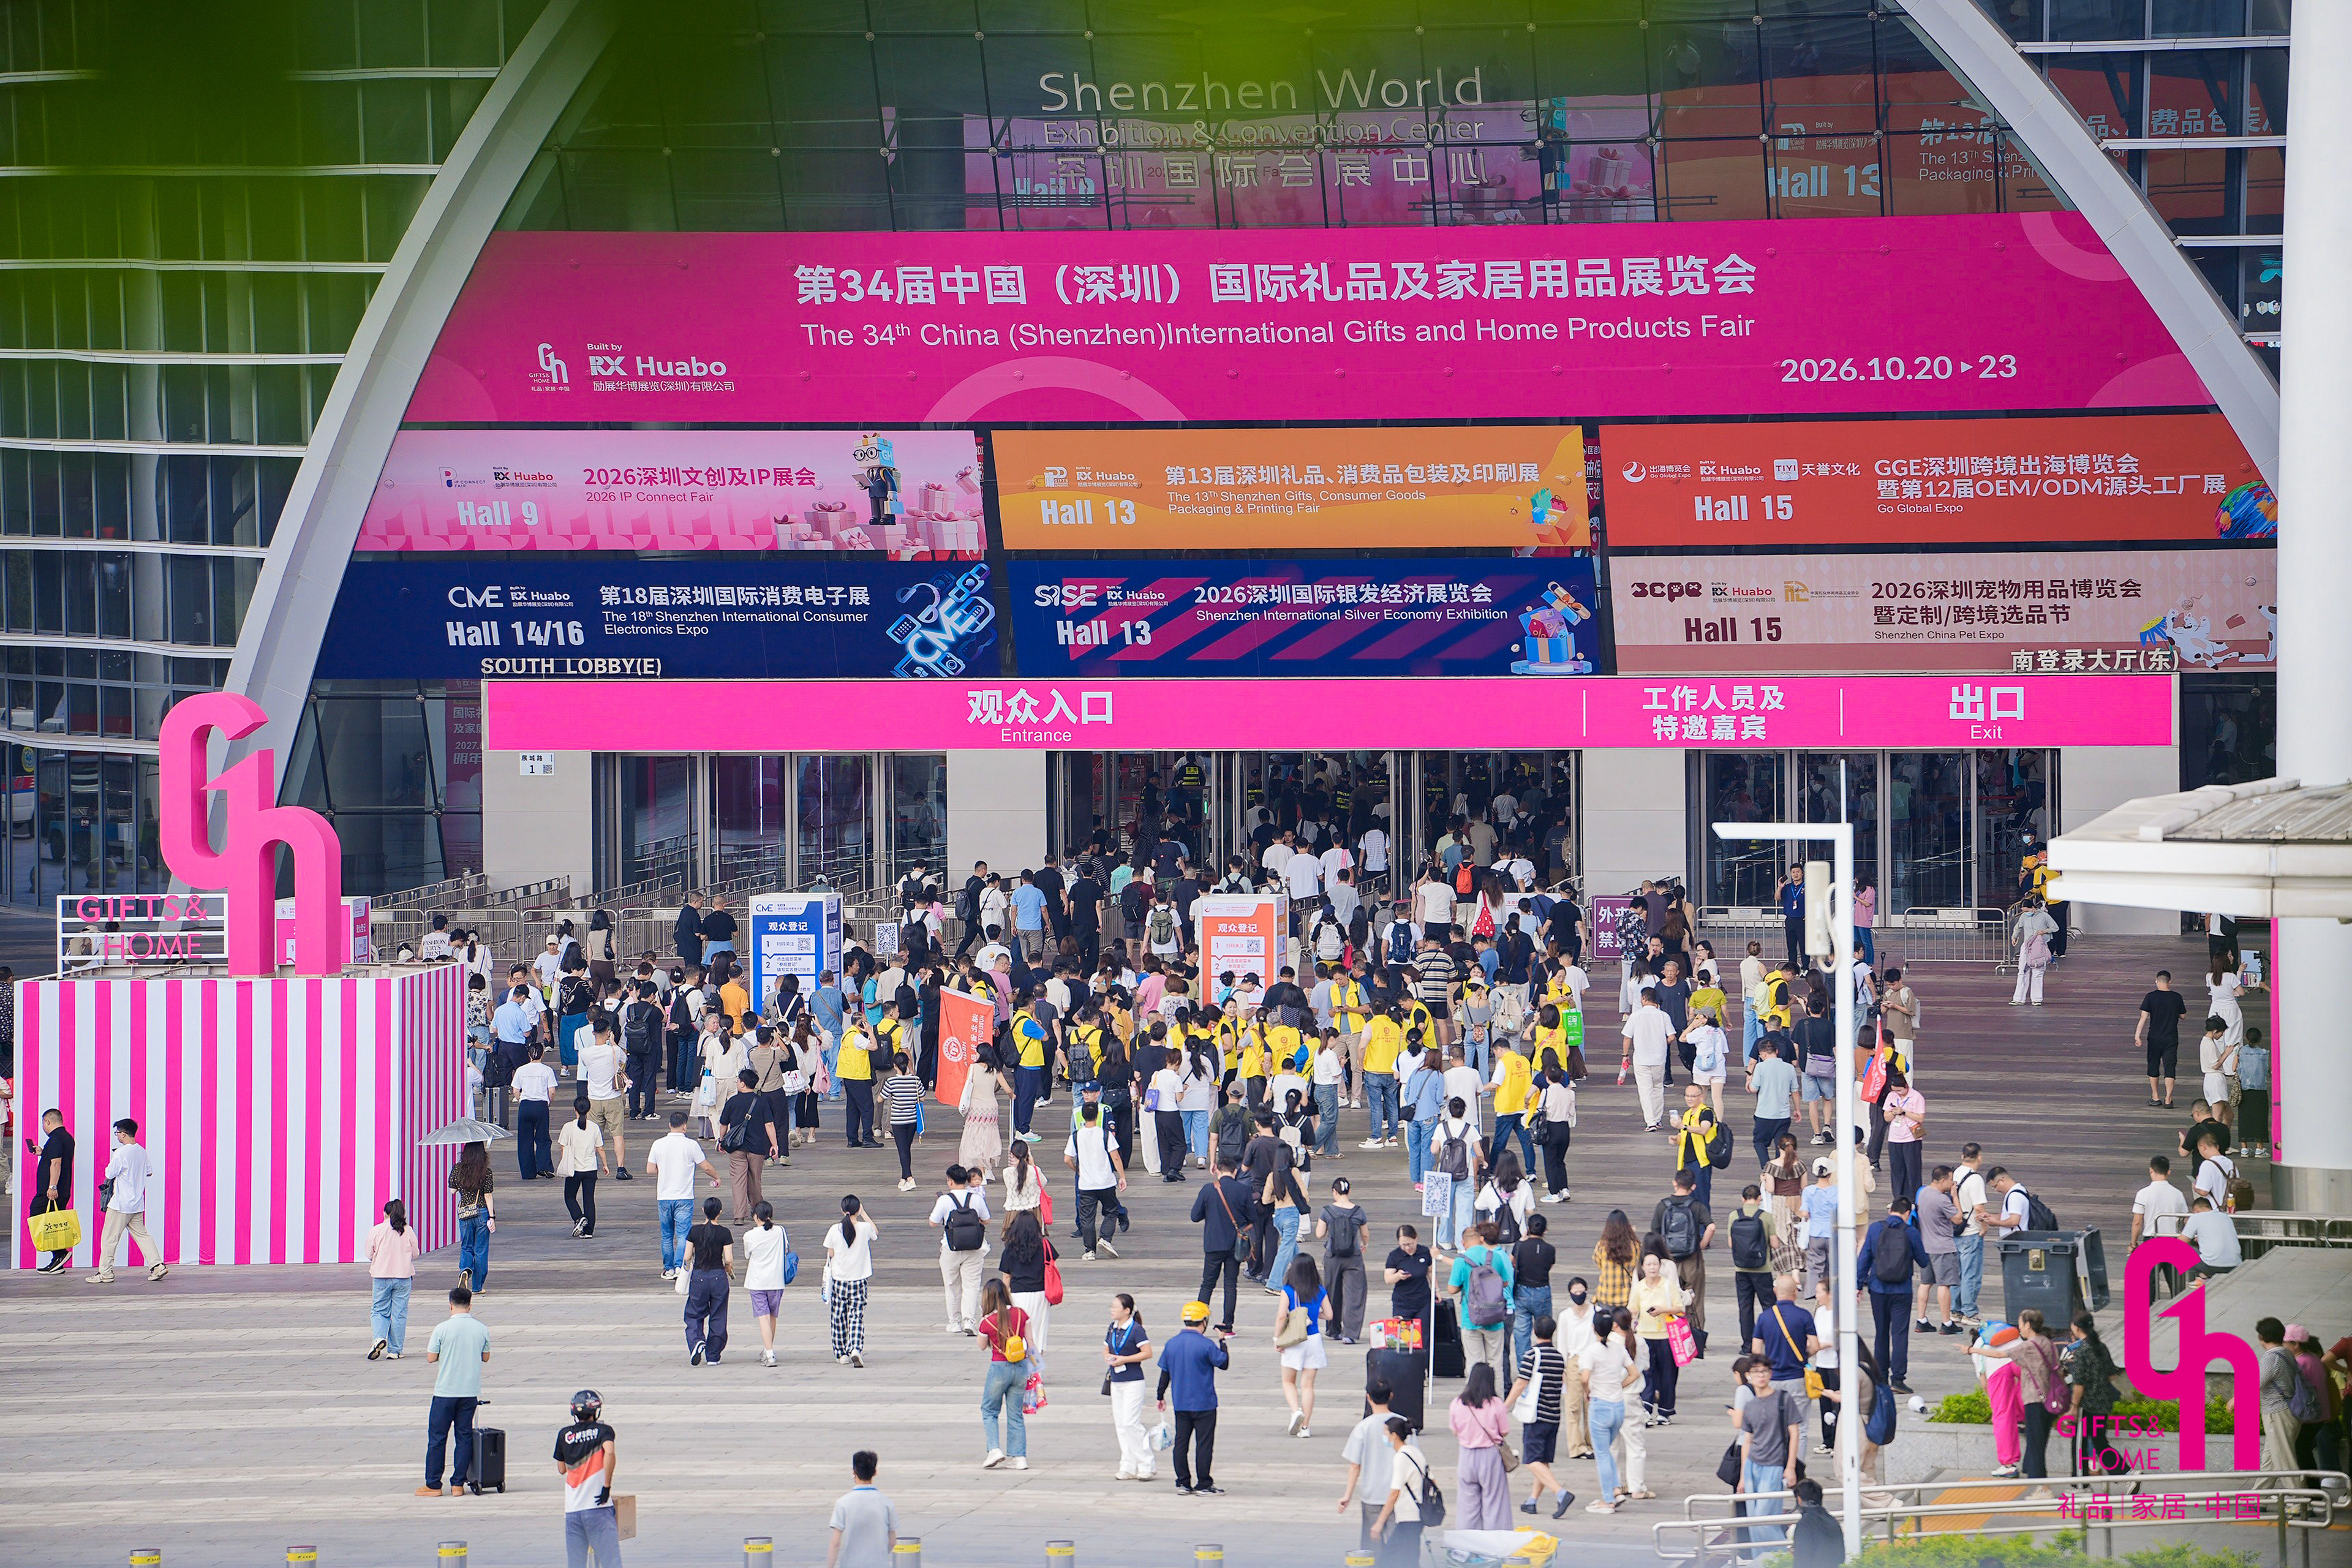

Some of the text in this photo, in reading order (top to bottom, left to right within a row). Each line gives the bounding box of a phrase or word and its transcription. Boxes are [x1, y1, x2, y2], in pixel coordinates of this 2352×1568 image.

[1039, 66, 1483, 113] Shenzhen World
[1044, 120, 1183, 145] Exhibition
[1193, 119, 1215, 142] &
[1221, 119, 1383, 143] Convention
[1391, 116, 1484, 140] Center
[1048, 149, 1488, 190] 深圳国际会展中心
[1920, 153, 1946, 165] The
[1768, 164, 1881, 198] Hall 13
[1920, 165, 1994, 183] Packaging
[801, 314, 1756, 351] The 34th China (Shenzhen)International Gifts and Home Products Fair
[611, 343, 623, 352] by
[589, 356, 727, 377] RX Huabo
[1781, 354, 2018, 383] 2026.10.20 23
[1164, 462, 1540, 487] 第13届深圳礼品、消费品包装及印刷展
[1649, 464, 1691, 473] 出海博览会
[1700, 466, 1761, 475] RX Huabo
[1801, 462, 1860, 477] 天誉文化
[1874, 453, 2139, 477] GGE深圳跨境出海博览会
[494, 472, 553, 481] RX Huabo
[582, 466, 816, 488] 2026深圳文创及IP展会
[1076, 472, 1135, 481] RX Huabo
[1876, 473, 2227, 500] 暨第12届OEM/ODM源头工厂展
[586, 491, 714, 502] 2026 IP Connect Fair
[1167, 489, 1426, 503] The 13Th Shenzhen Gifts, Consumer Goods
[457, 500, 539, 526] Hall 9
[1040, 499, 1137, 525] Hall 13
[1169, 502, 1321, 516] Packaging & Printing Fair
[1694, 495, 1793, 521] Hall 15
[1877, 503, 1963, 514] Go Global Expo
[448, 586, 504, 608] CME
[511, 591, 570, 600] RX Huabo
[599, 586, 870, 607] 第18届深圳国际消费电子展
[1107, 590, 1165, 600] RX Huabo
[1194, 583, 1493, 605] 2026深圳国际银发经济展览会
[1712, 587, 1772, 596] RX Huabo
[1871, 578, 2142, 600] 2026深圳宠物用品博览会
[603, 611, 868, 622] The 18th Shenzhen International Consumer
[1196, 608, 1508, 622] Shenzhen International Silver Economy Exhibition
[1873, 604, 2071, 626] 暨定制/跨境选品节
[446, 620, 584, 646] Hall 14/16
[604, 624, 709, 637] Electronics Expo
[1057, 620, 1152, 645] Hall 13
[1685, 617, 1782, 643] Hall 15
[1874, 631, 1924, 639] Shenzhen
[1928, 631, 1956, 639] China
[1980, 631, 2005, 640] Expo
[481, 657, 662, 676] SOUTH LOBBY(E)
[2011, 648, 2180, 671] 南登录大厅(东)
[967, 688, 1113, 725] 观众入口
[1642, 685, 1785, 711] 工作人员及
[1949, 683, 2024, 722] 出口
[1001, 728, 1072, 742] Entrance
[1653, 714, 1767, 741] 特邀嘉宾
[1971, 725, 2002, 739] Exit
[529, 764, 535, 774] 1
[768, 921, 808, 932] 观众登记
[1218, 923, 1257, 933] 观众登记
[105, 933, 203, 960] HOME
